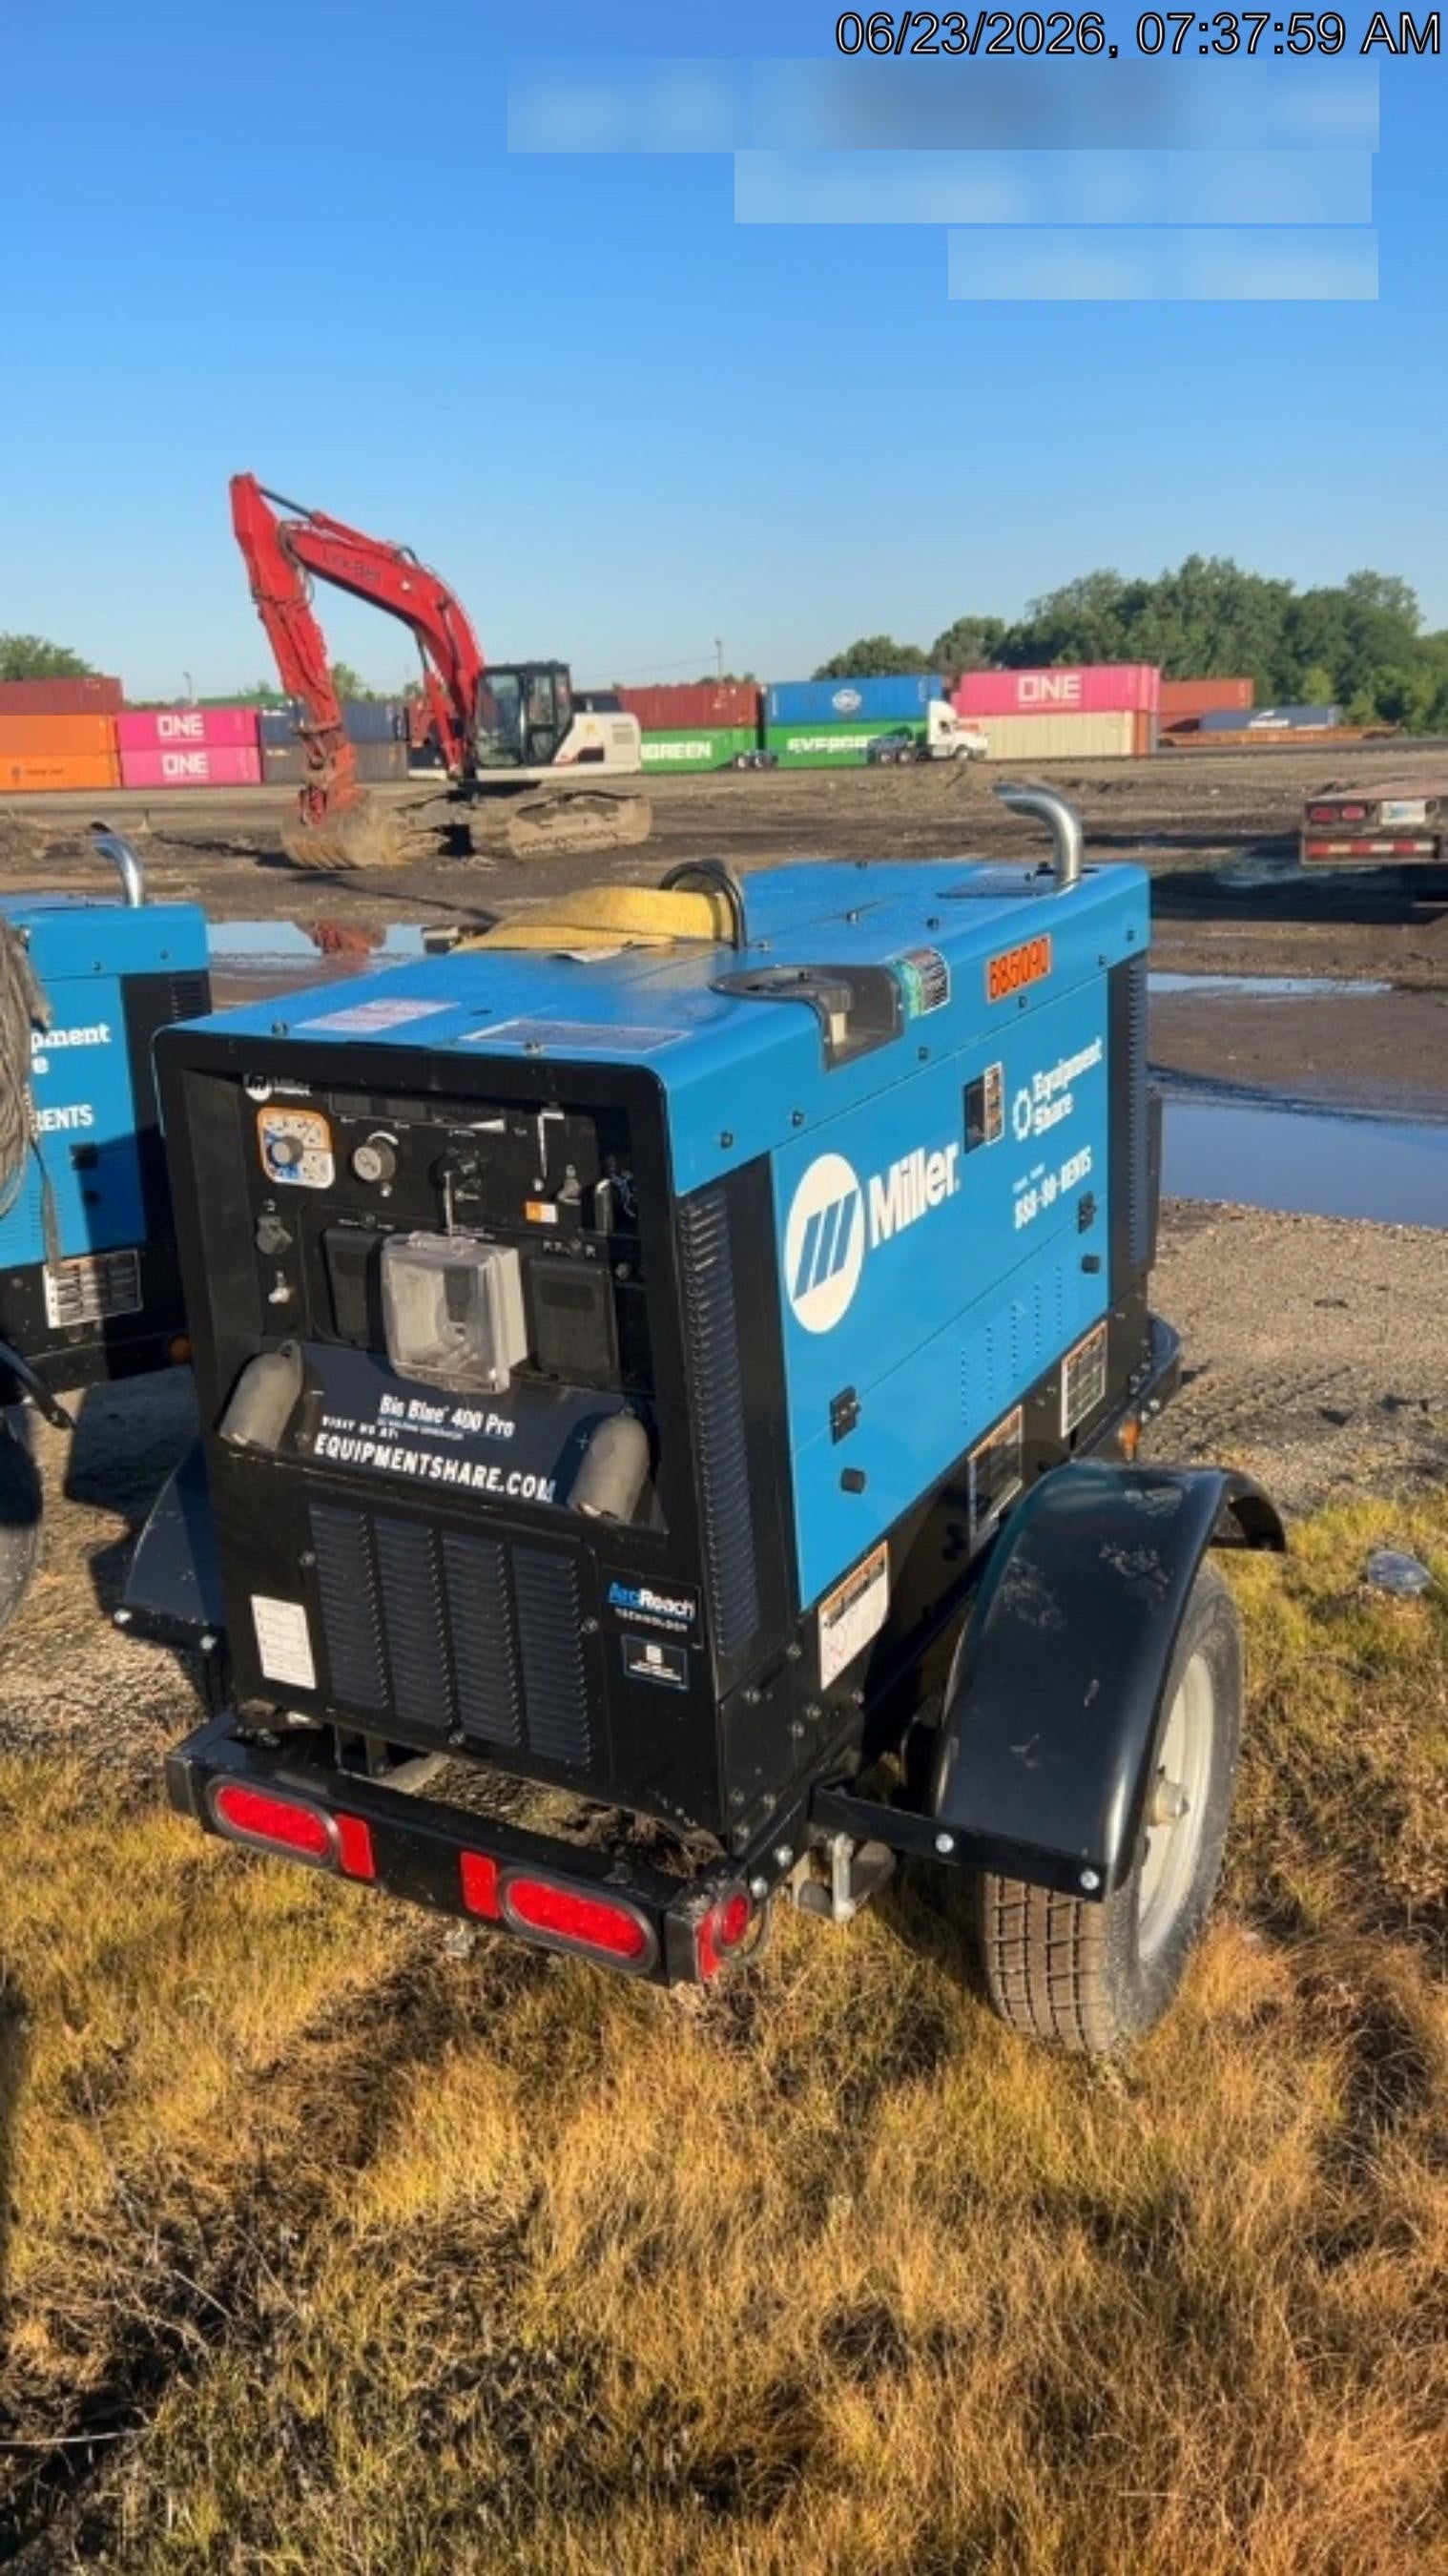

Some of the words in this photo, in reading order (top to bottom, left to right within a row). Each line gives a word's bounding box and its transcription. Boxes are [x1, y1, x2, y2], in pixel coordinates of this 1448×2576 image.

[1018, 675, 1081, 702] ONE
[156, 714, 204, 737] ONE
[162, 752, 208, 777] ONE
[641, 741, 711, 759] GREEN
[31, 1022, 112, 1054] pment
[1032, 1036, 1102, 1103] Equipment
[1034, 1092, 1073, 1136] Share
[868, 1141, 960, 1250] Miller
[451, 1407, 484, 1432] 400
[486, 1413, 514, 1438] Pro
[314, 1432, 556, 1504] EQUIPMENTSHARE.COM
